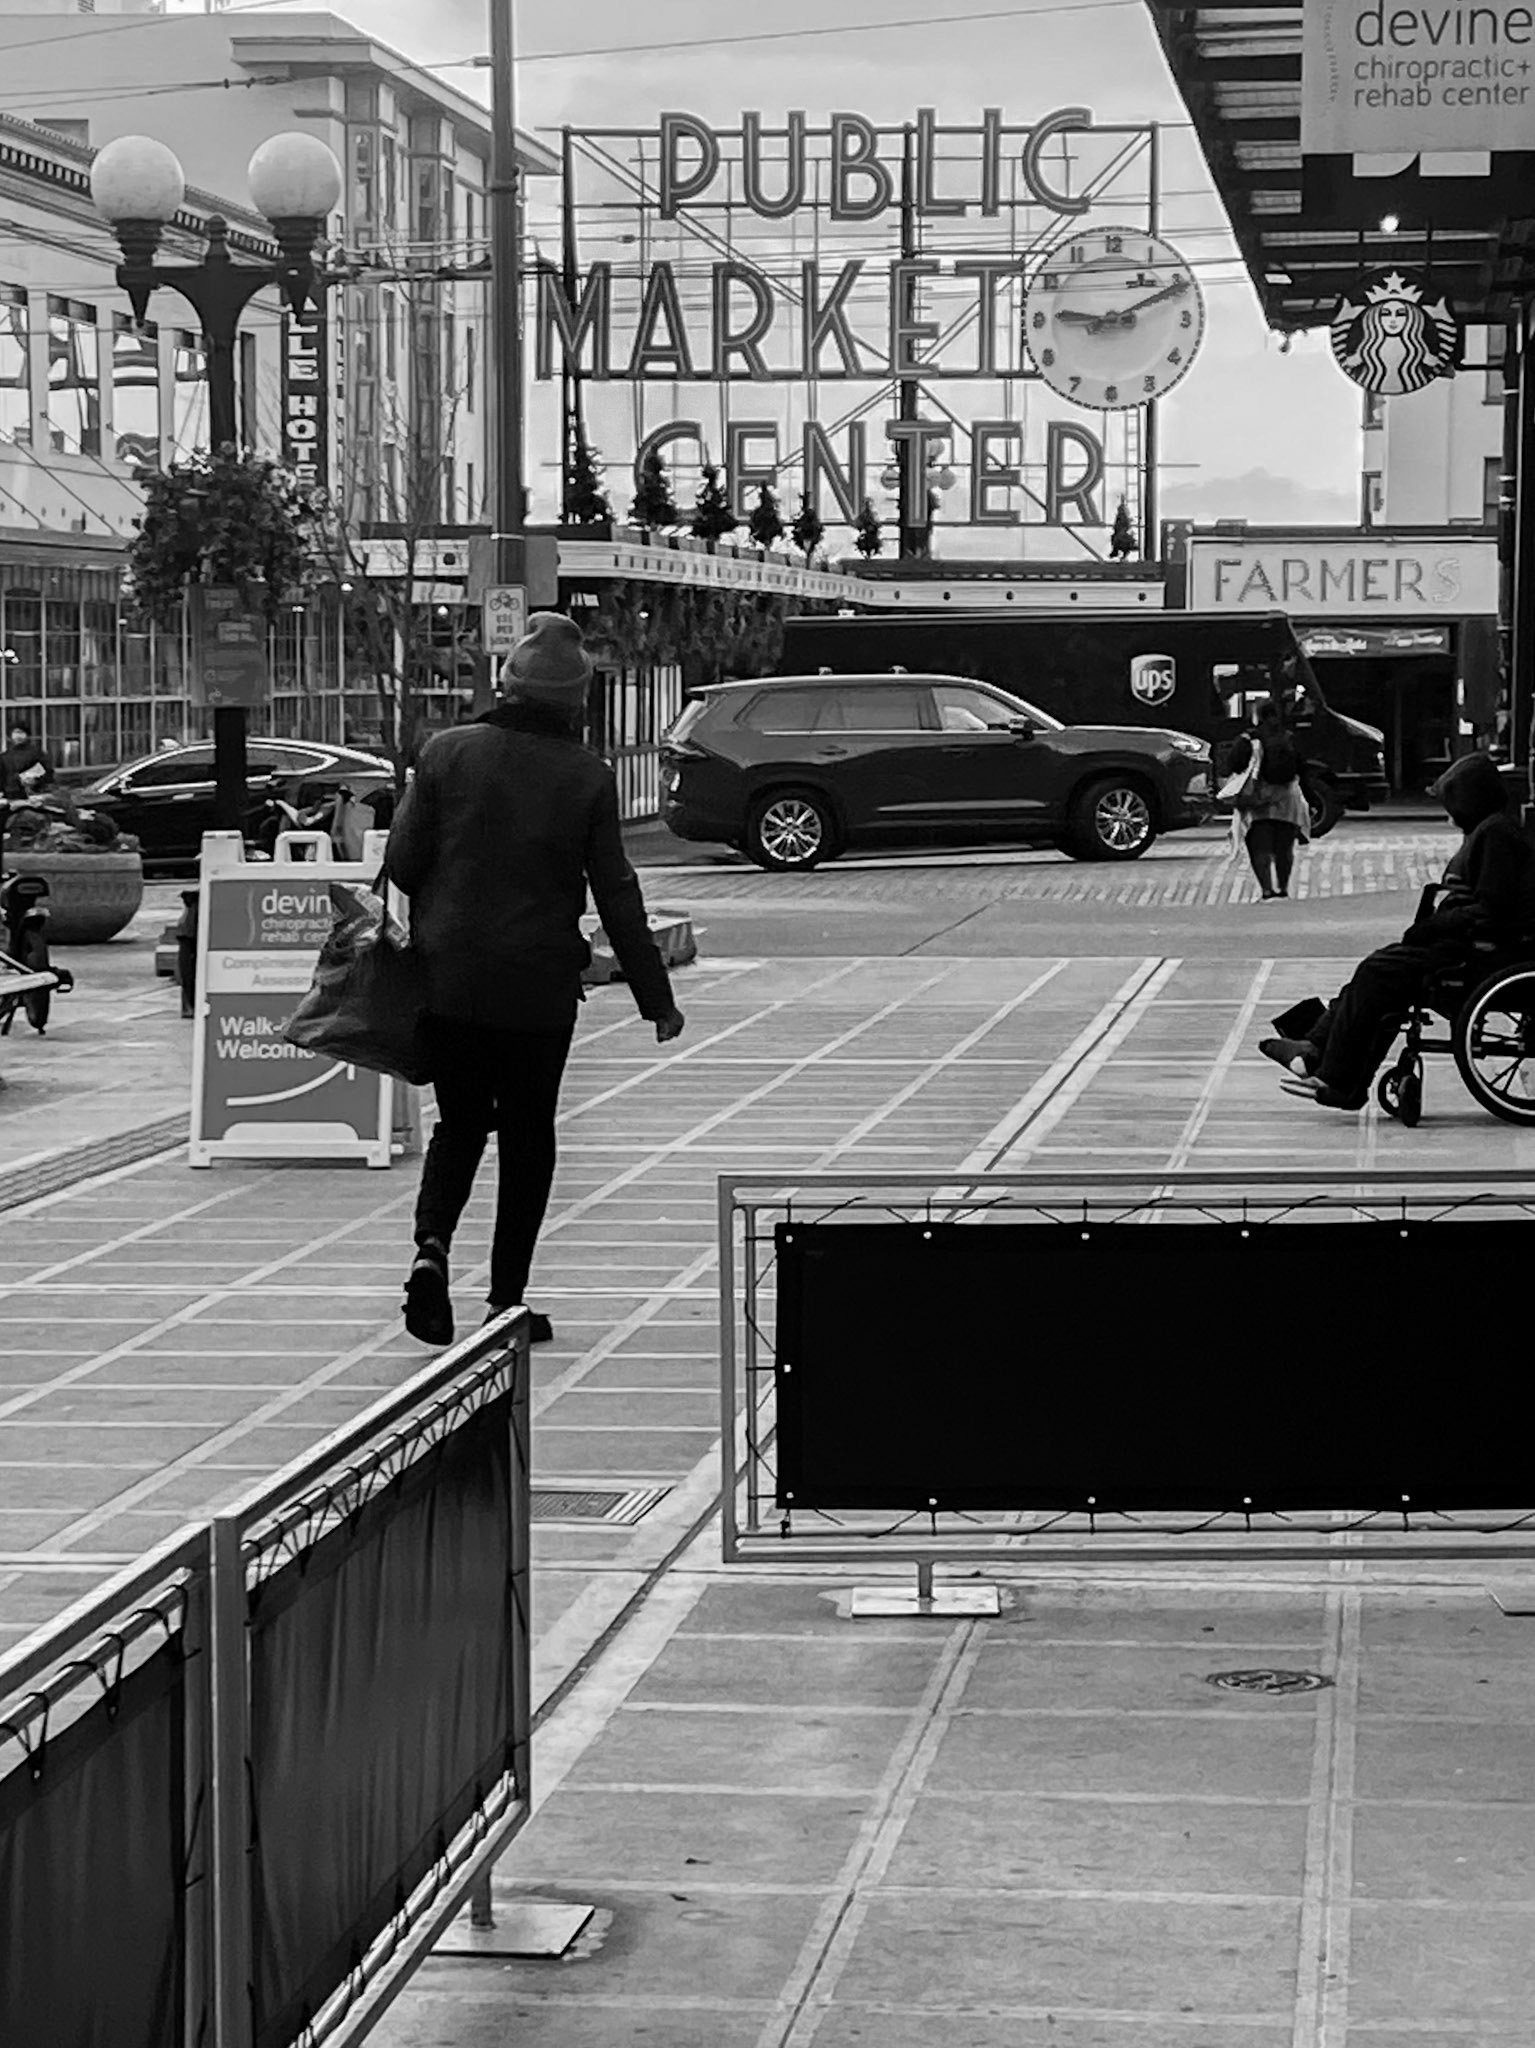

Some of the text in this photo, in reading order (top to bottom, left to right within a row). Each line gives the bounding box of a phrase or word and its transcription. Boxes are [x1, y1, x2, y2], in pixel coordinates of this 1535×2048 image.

[1355, 0, 1534, 46] devine
[1353, 53, 1531, 86] chiropractic+
[1353, 81, 1531, 108] rehab center
[659, 106, 1093, 220] PUBLIC
[1105, 234, 1123, 253] 12
[535, 258, 1025, 381] MARKET
[1179, 310, 1192, 329] 3
[1167, 347, 1182, 366] 4
[1068, 375, 1082, 393] 7
[286, 394, 319, 487] HOTE
[634, 420, 1103, 526] CENTER
[1213, 557, 1460, 602] FARMERS
[1135, 669, 1172, 698] ups
[261, 887, 333, 915] devin
[261, 930, 300, 943] rehab
[219, 1016, 287, 1036] Walk-
